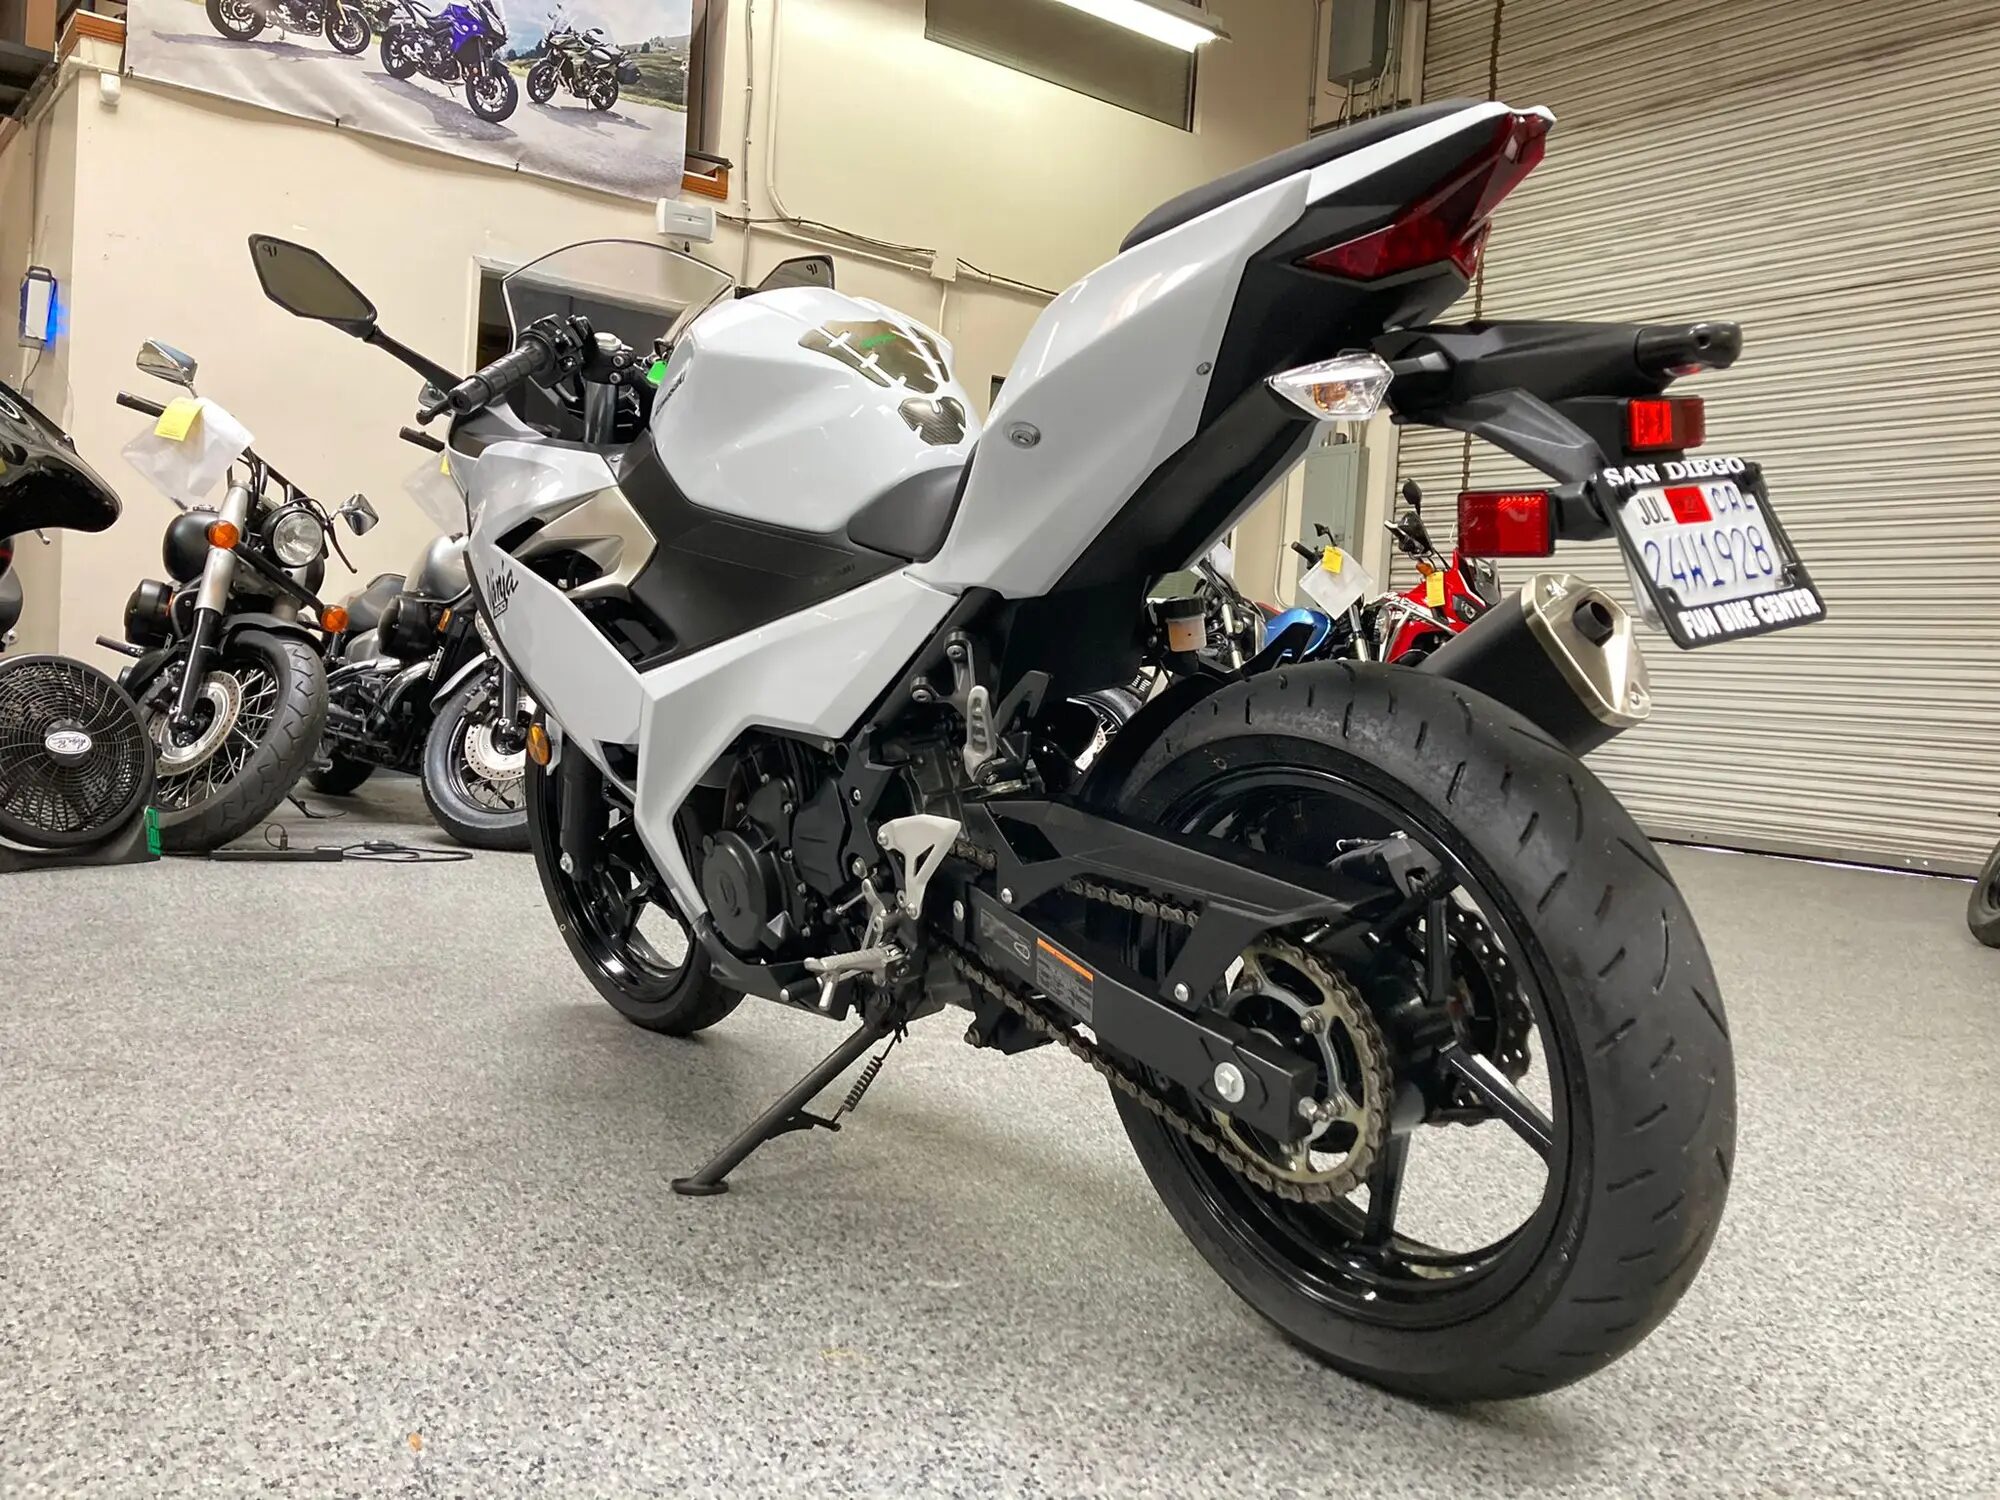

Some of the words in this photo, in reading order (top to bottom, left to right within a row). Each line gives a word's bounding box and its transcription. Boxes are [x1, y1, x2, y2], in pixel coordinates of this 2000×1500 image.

[1603, 464, 1661, 487] SAN
[1663, 457, 1746, 480] DIEGO
[1637, 495, 1671, 526] JUL
[1677, 606, 1722, 640] FUN
[1713, 599, 1761, 632] BIKE
[1753, 587, 1822, 624] CENTER
